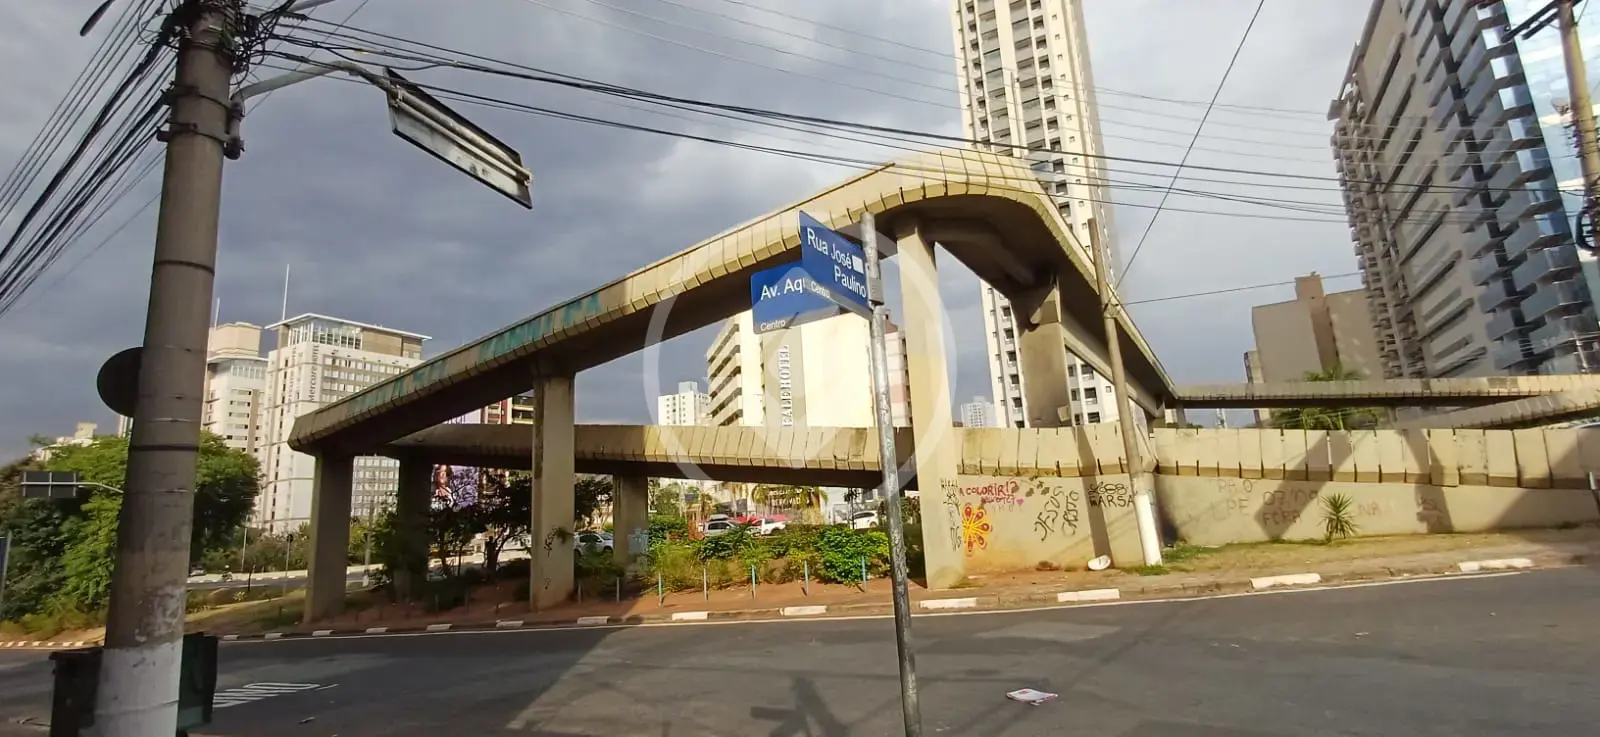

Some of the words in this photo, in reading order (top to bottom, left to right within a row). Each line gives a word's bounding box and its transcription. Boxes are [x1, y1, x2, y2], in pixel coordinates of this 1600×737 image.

[806, 227, 828, 255] Rua
[831, 243, 851, 269] José
[810, 280, 831, 298] Centro
[834, 264, 867, 298] Paulino
[760, 285, 780, 300] Av.
[760, 319, 786, 331] Centro
